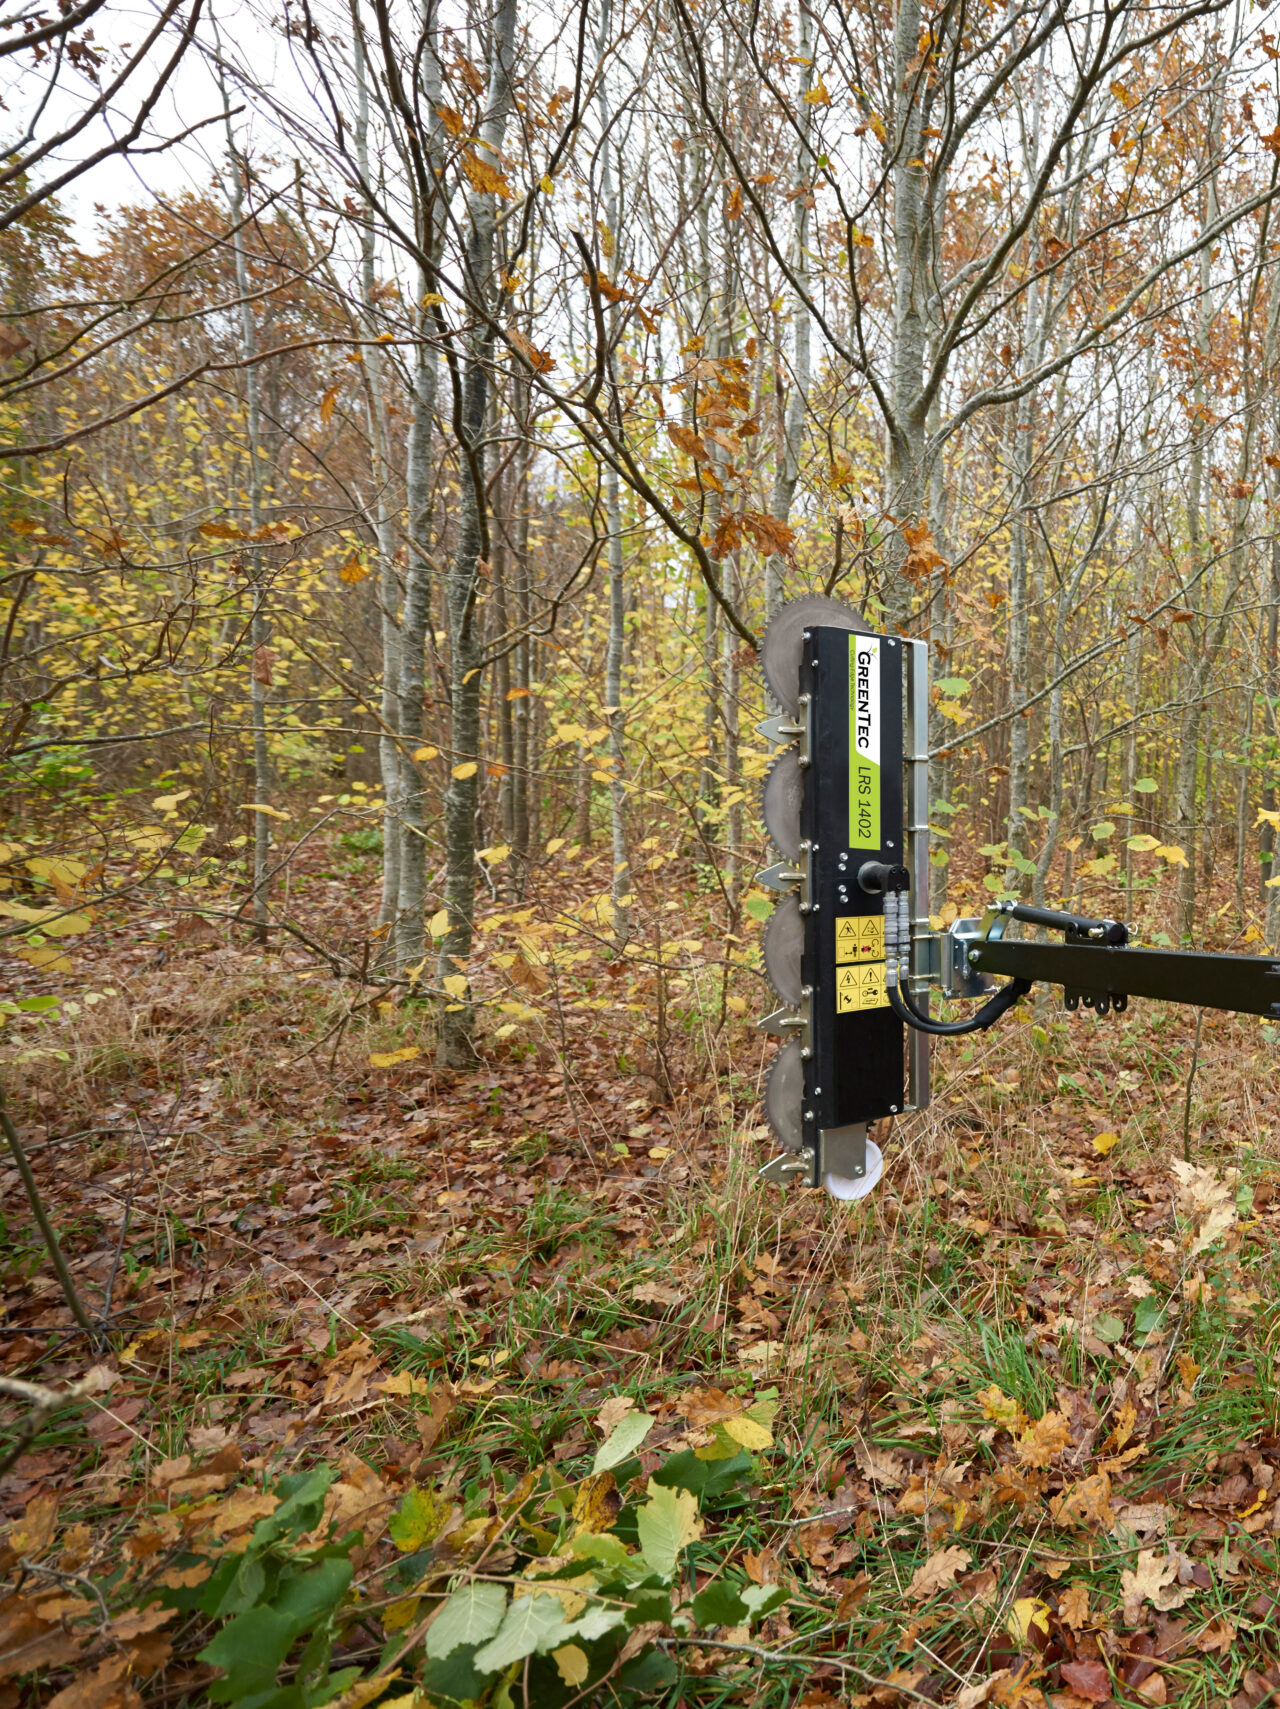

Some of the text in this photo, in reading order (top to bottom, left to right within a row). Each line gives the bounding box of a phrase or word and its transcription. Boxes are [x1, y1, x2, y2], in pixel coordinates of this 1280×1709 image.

[858, 651, 871, 749] GREENTEC
[858, 766, 871, 839] LRS 1402
